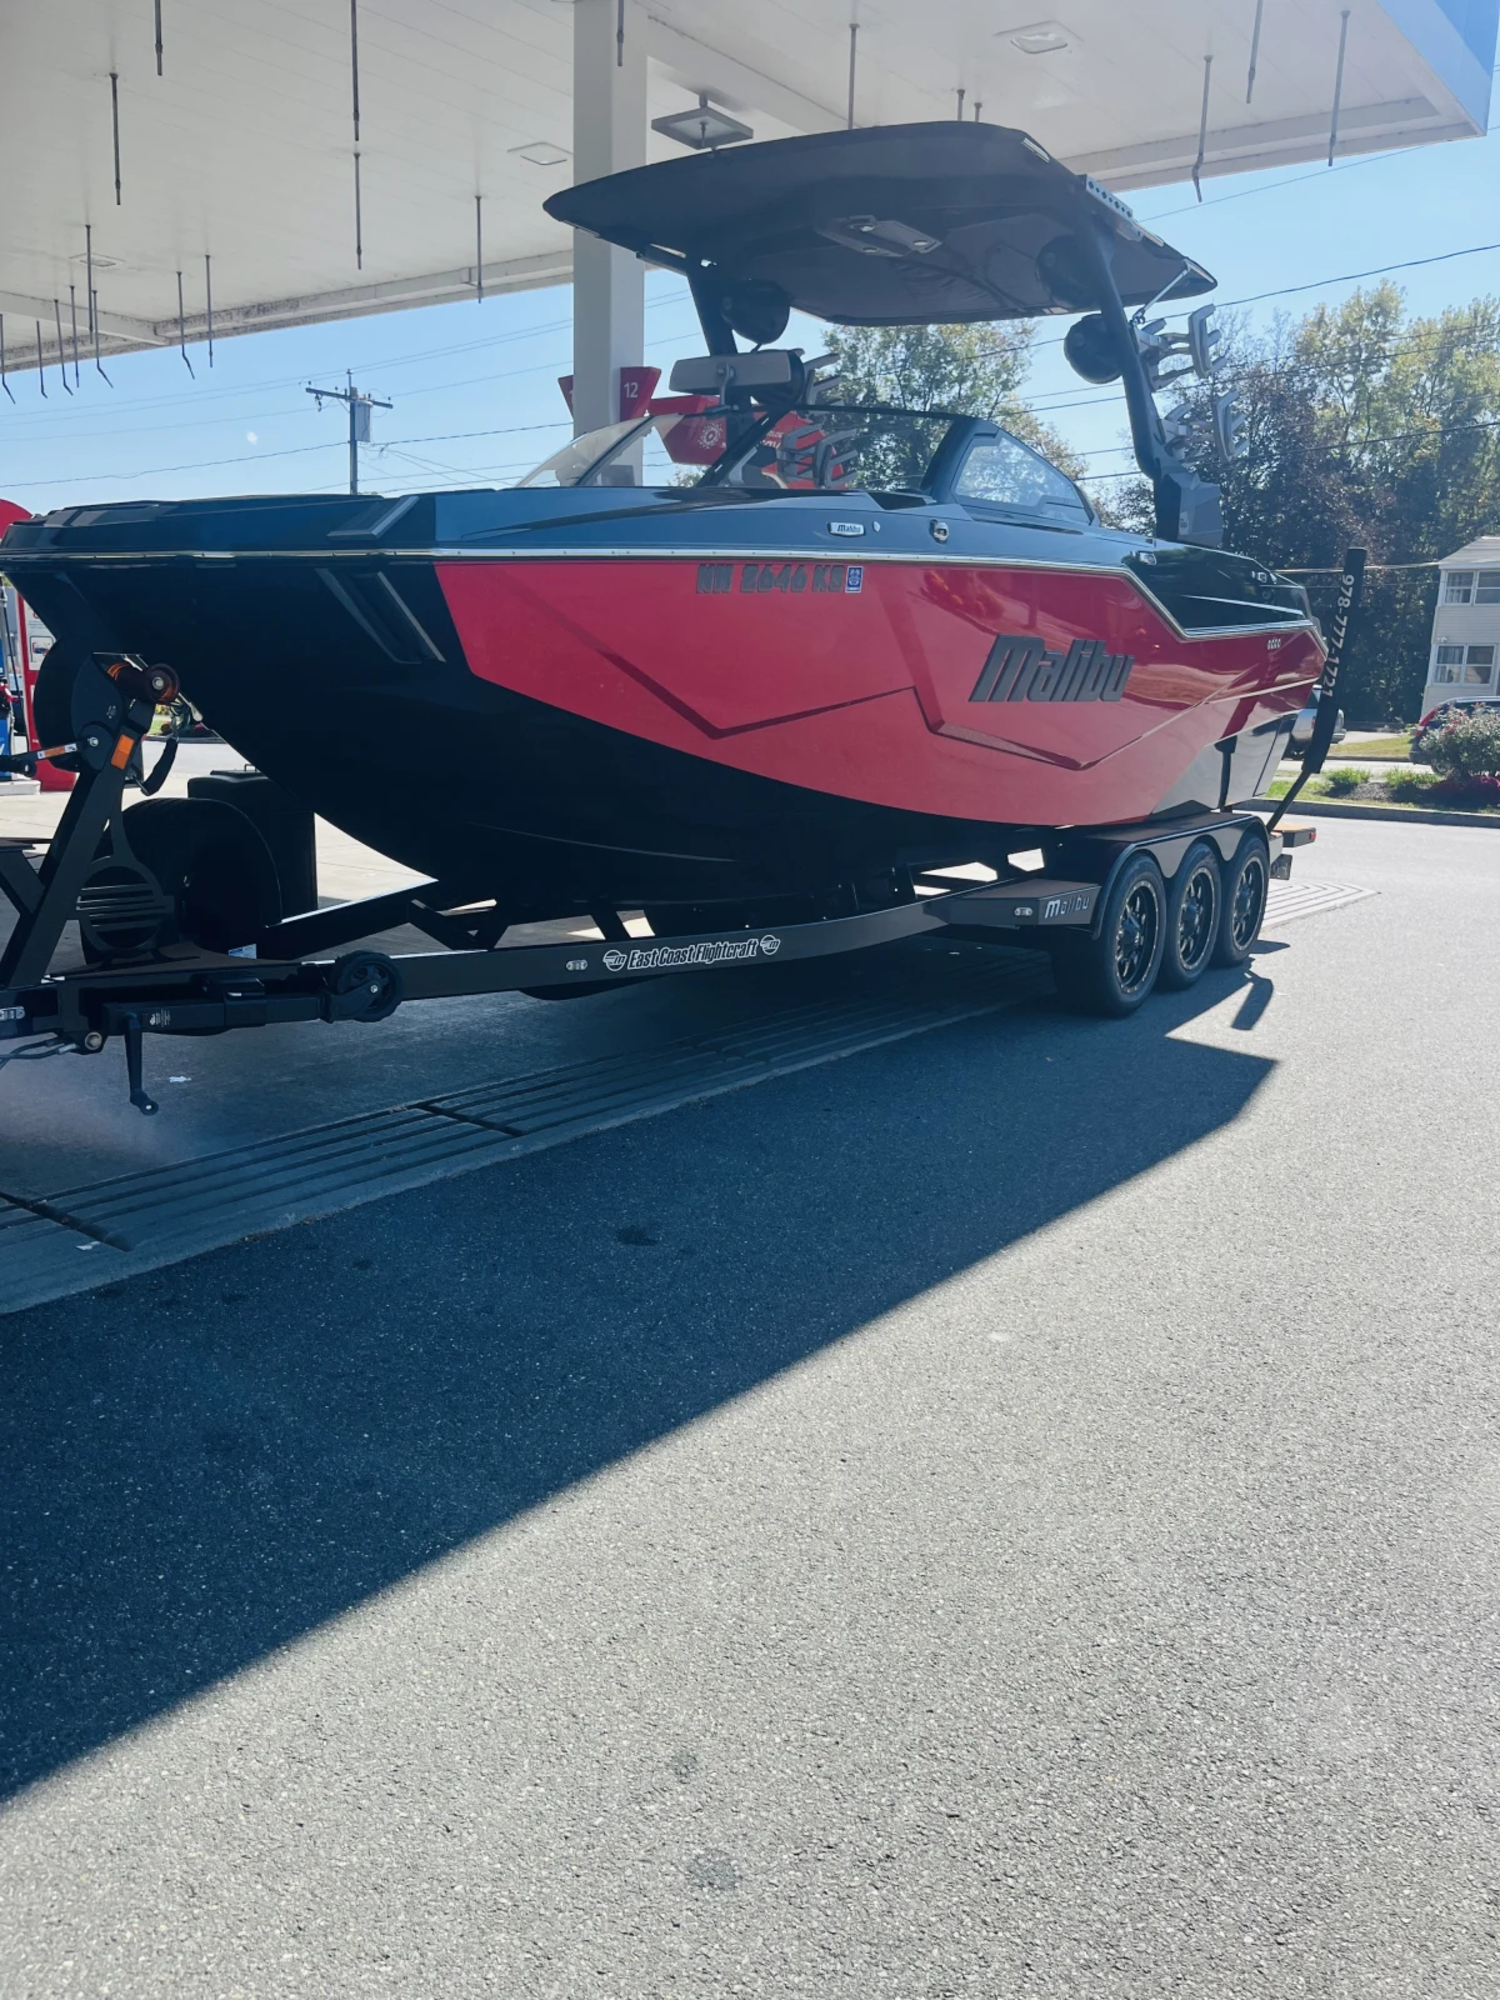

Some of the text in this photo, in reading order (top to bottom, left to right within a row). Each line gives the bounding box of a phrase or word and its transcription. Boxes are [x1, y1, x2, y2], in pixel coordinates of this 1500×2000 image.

[624, 382, 638, 398] 12
[740, 563, 808, 593] 2646
[1322, 574, 1355, 698] 978-777-1721
[967, 633, 1136, 702] Malibu
[1044, 895, 1090, 919] Malibu
[627, 950, 657, 970] East
[657, 946, 695, 966] Coast
[693, 938, 759, 965] Flightcraft
